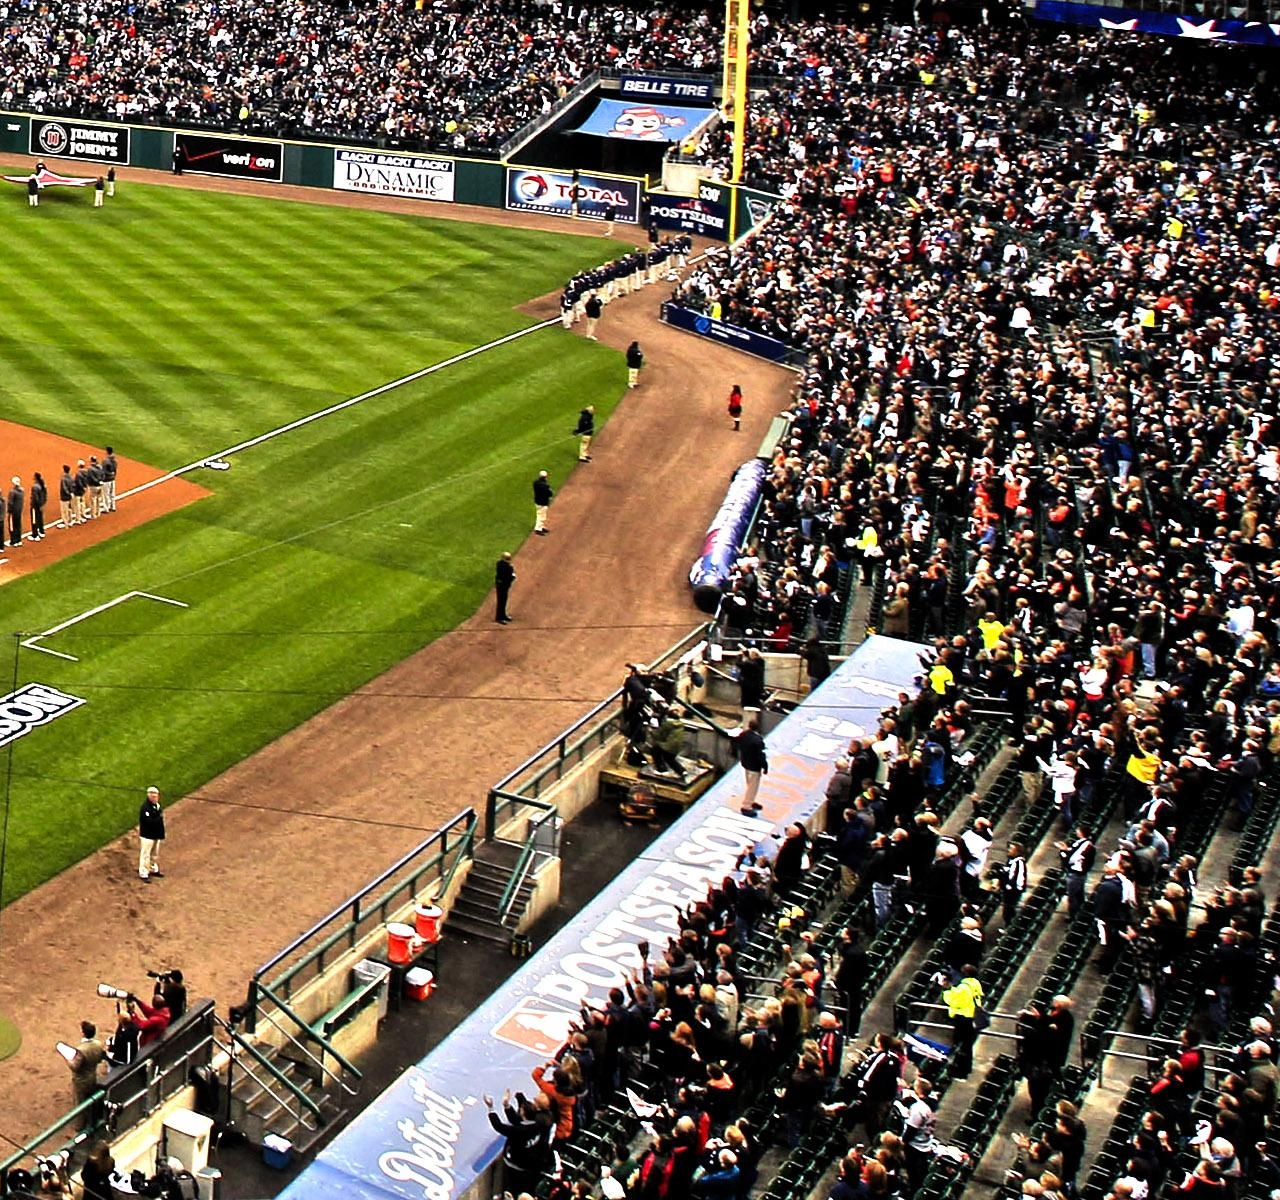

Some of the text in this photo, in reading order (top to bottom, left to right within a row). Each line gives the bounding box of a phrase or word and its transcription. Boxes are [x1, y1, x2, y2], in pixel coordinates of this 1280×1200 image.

[622, 79, 710, 98] BELLE TIRE
[70, 127, 119, 143] JIMMY
[69, 141, 118, 157] JOHN'S
[222, 152, 275, 170] verizon
[340, 151, 450, 172] BACK! BACK! BACK!
[346, 161, 444, 190] DYNAMIC
[650, 205, 724, 229] POSTSEASON
[533, 805, 777, 1009] POSTSEASON
